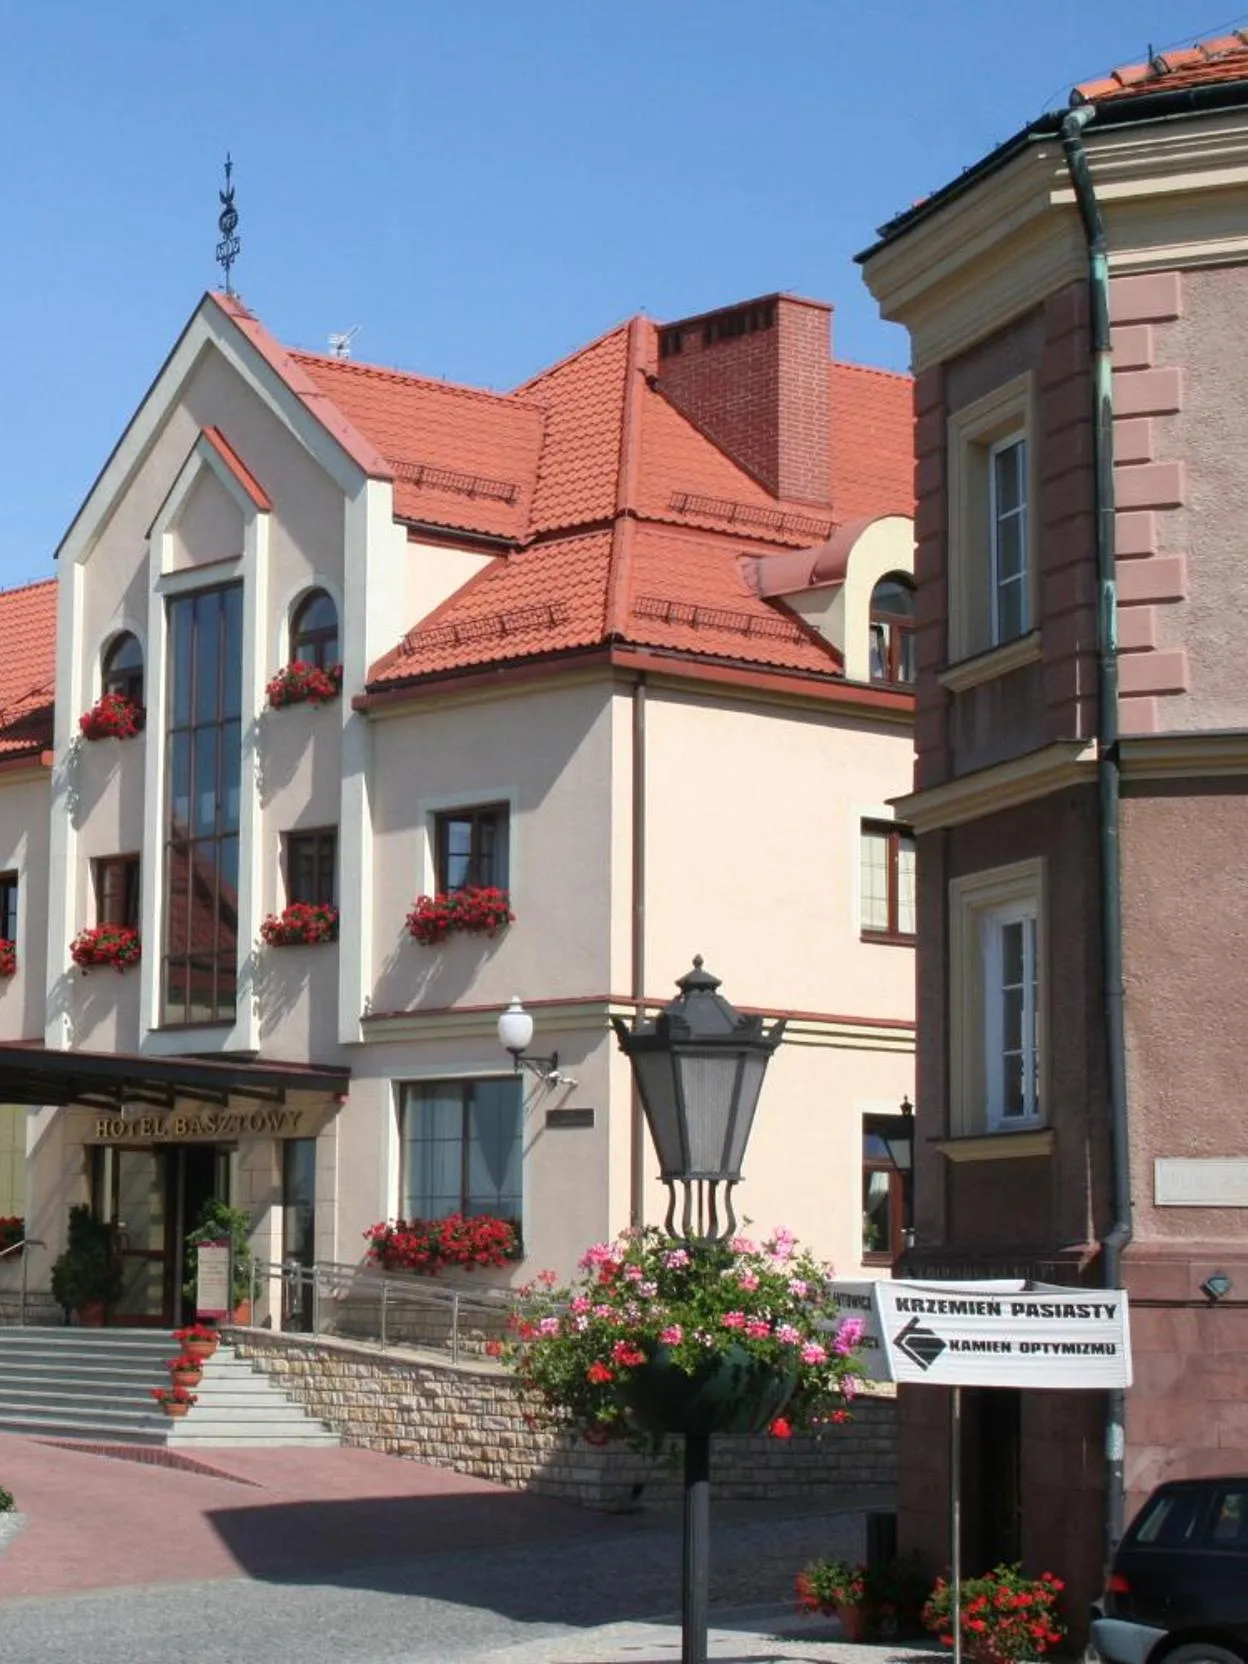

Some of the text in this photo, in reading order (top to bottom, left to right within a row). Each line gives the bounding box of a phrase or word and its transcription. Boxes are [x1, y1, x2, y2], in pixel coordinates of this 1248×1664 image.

[95, 1109, 303, 1138] HOTEL BASZTOWY
[1011, 1303, 1117, 1319] PASIASTY
[1019, 1342, 1116, 1355] OPTYMIZMU
